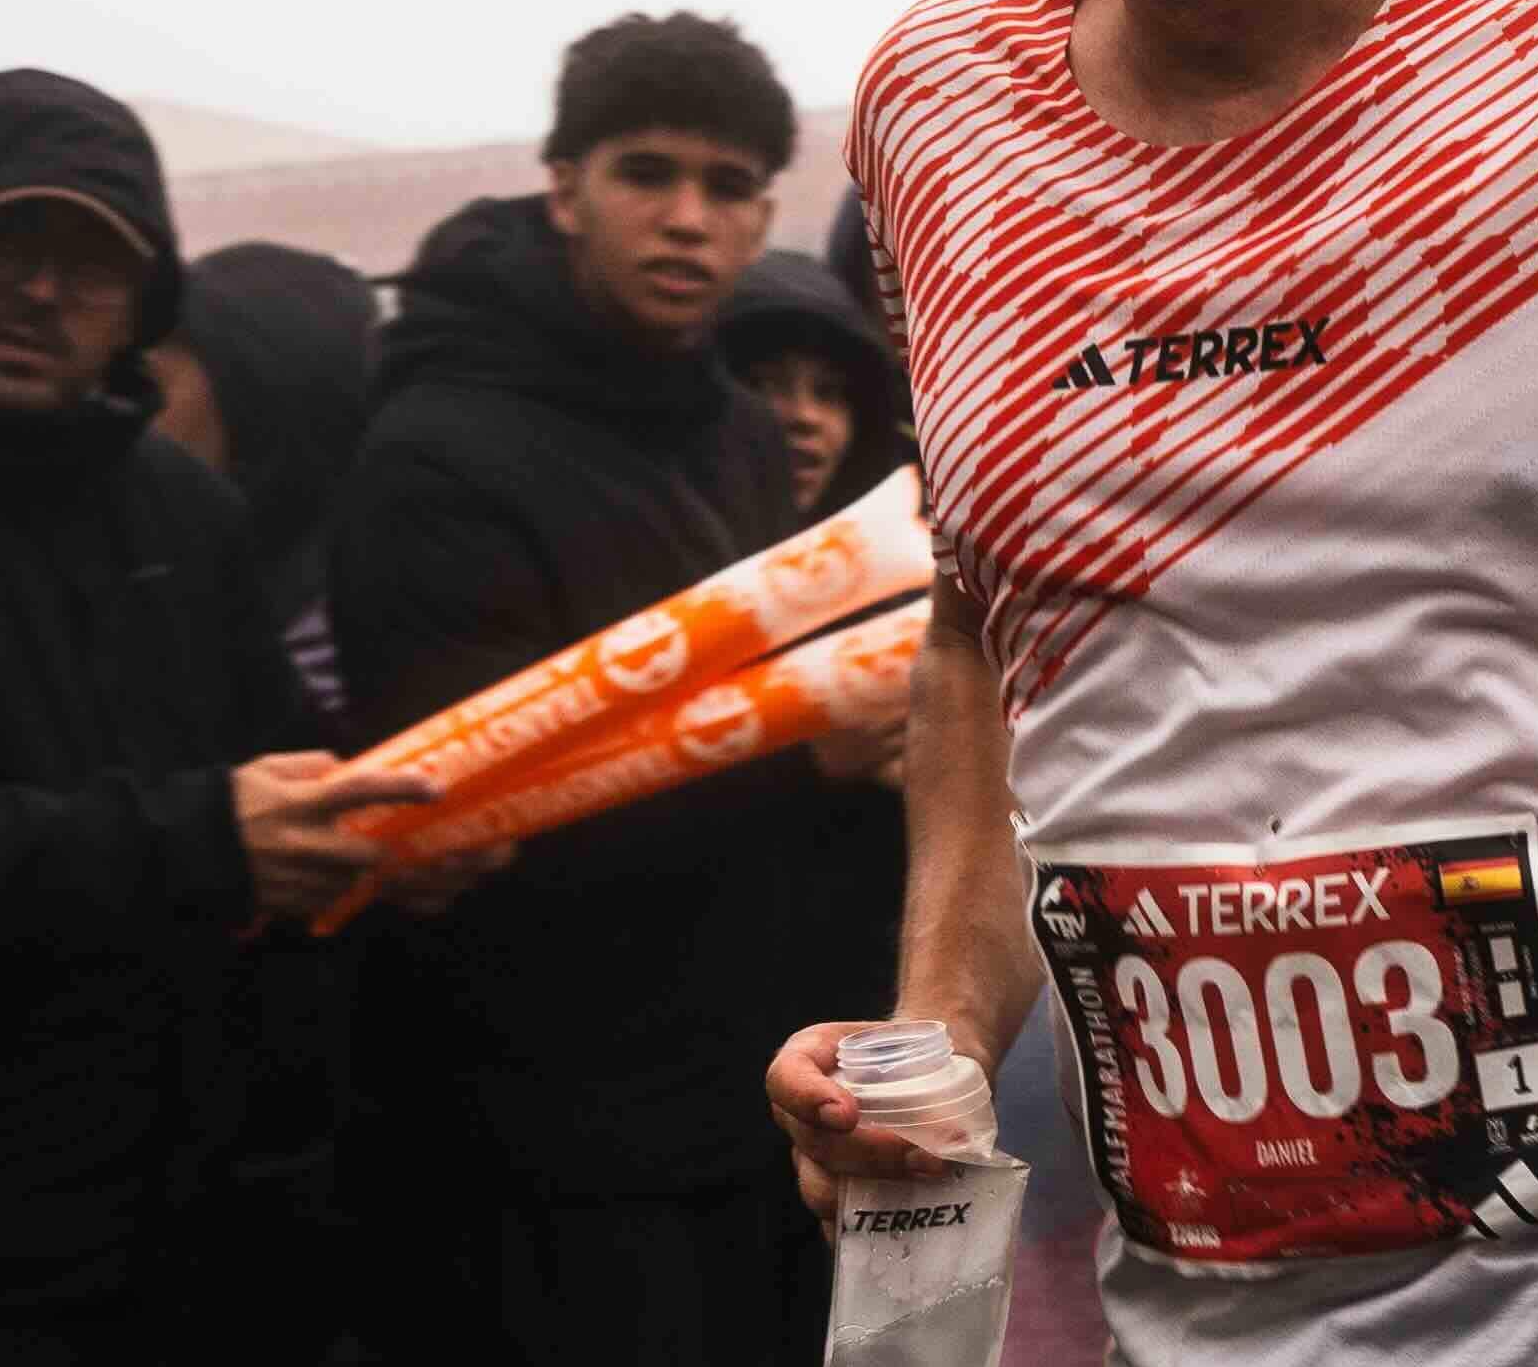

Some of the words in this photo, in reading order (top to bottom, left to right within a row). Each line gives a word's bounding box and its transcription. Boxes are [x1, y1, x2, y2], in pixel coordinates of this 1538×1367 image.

[1124, 317, 1330, 384] TERREX
[1178, 867, 1391, 937] TERREX
[1114, 939, 1460, 1125] 3003
[1507, 1053, 1532, 1095] 1
[1256, 1138, 1318, 1167] DANIEL
[854, 1201, 972, 1233] TERREX
